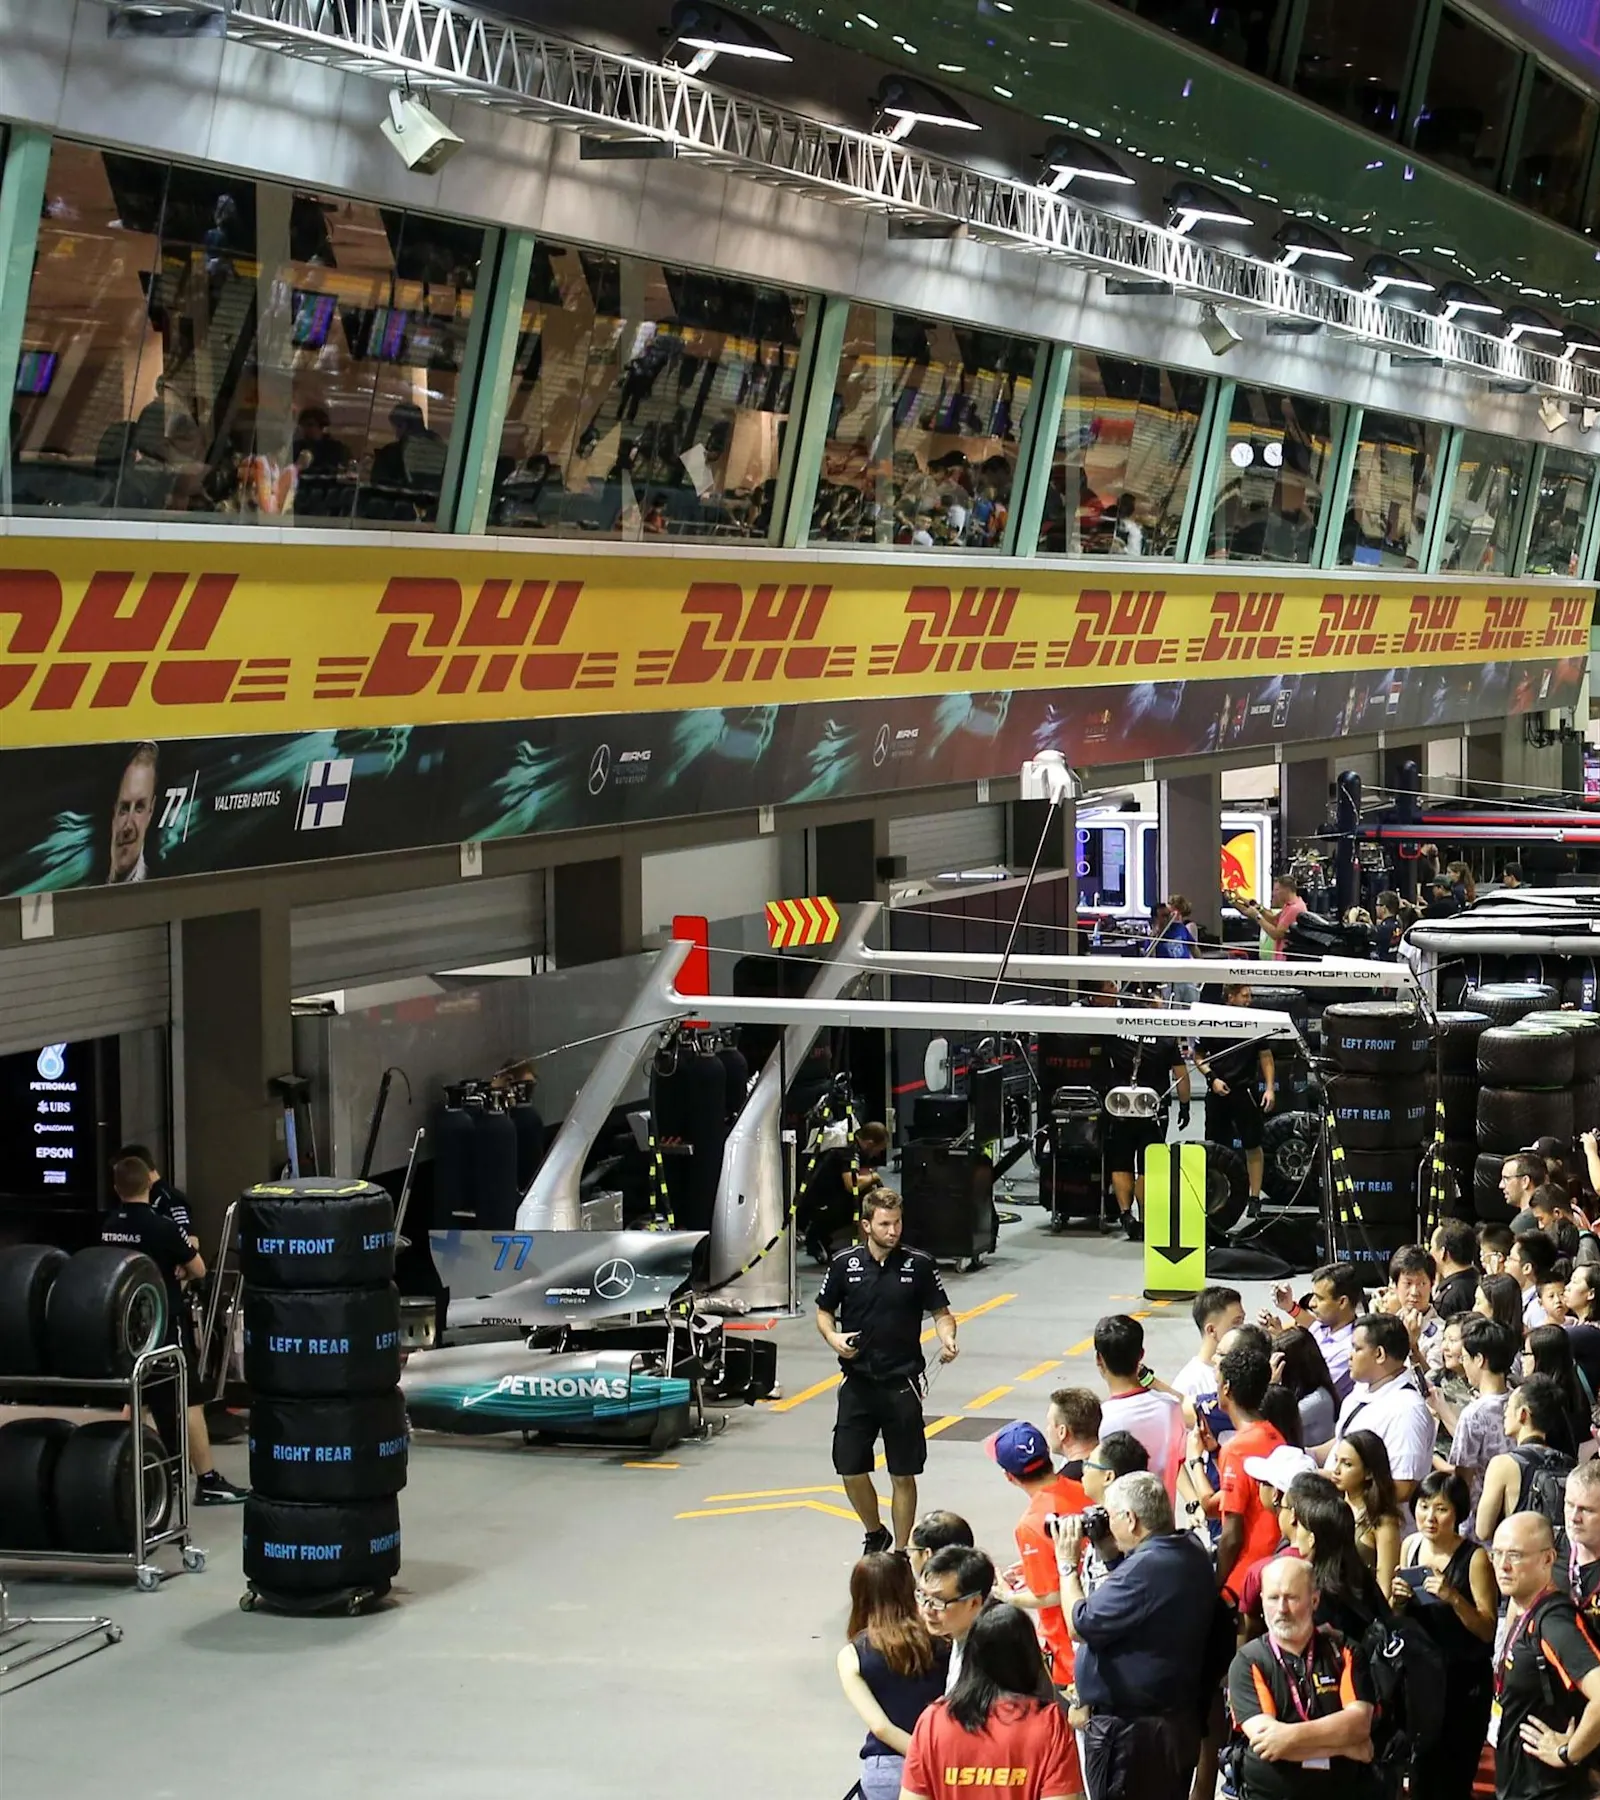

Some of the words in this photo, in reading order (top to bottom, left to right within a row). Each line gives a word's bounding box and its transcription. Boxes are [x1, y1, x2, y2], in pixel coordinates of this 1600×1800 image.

[892, 586, 1020, 673] DHL
[1064, 589, 1166, 667] DHL
[1201, 591, 1285, 661] DHL
[1312, 593, 1380, 657] DHL
[1401, 595, 1460, 652] DHL
[1476, 596, 1528, 649] DHL
[1543, 597, 1587, 646] DHL
[359, 577, 585, 697] DHL
[667, 582, 833, 684] DHL
[626, 750, 652, 761] AMG
[158, 787, 188, 828] 77
[215, 793, 251, 811] VALTTERI
[251, 790, 280, 808] BOTTAS
[1583, 982, 1593, 1004] PS1
[1116, 1017, 1259, 1028] @MERCEDESAMGF1
[1341, 1038, 1362, 1049] LEFT
[1365, 1039, 1396, 1051] FRONT
[30, 1082, 77, 1091] PETRONAS
[50, 1102, 70, 1112] UBS
[1337, 1108, 1359, 1119] LEFT
[1363, 1109, 1391, 1120] REAR
[36, 1148, 73, 1158] EPSON
[1368, 1181, 1393, 1192] REAR
[257, 1238, 284, 1254] LEFT
[289, 1238, 335, 1255] FRONT
[363, 1232, 387, 1250] LEFT
[491, 1235, 534, 1271] 77
[1337, 1251, 1361, 1261] RIGT
[1362, 1250, 1391, 1261] FRNT
[556, 1287, 591, 1295] AMG
[481, 1317, 522, 1325] PETRONAS
[269, 1336, 302, 1353] LEFT
[309, 1338, 349, 1354] REAR
[376, 1332, 397, 1350] LEFT
[499, 1375, 628, 1399] PETRONAS
[273, 1445, 310, 1461] RIGHT
[315, 1446, 352, 1462] REAR
[379, 1438, 403, 1457] RIGHT
[264, 1542, 297, 1559] RIGHT
[301, 1544, 342, 1560] FRONT
[370, 1534, 394, 1553] RIGHT
[944, 1767, 1027, 1786] USHER
